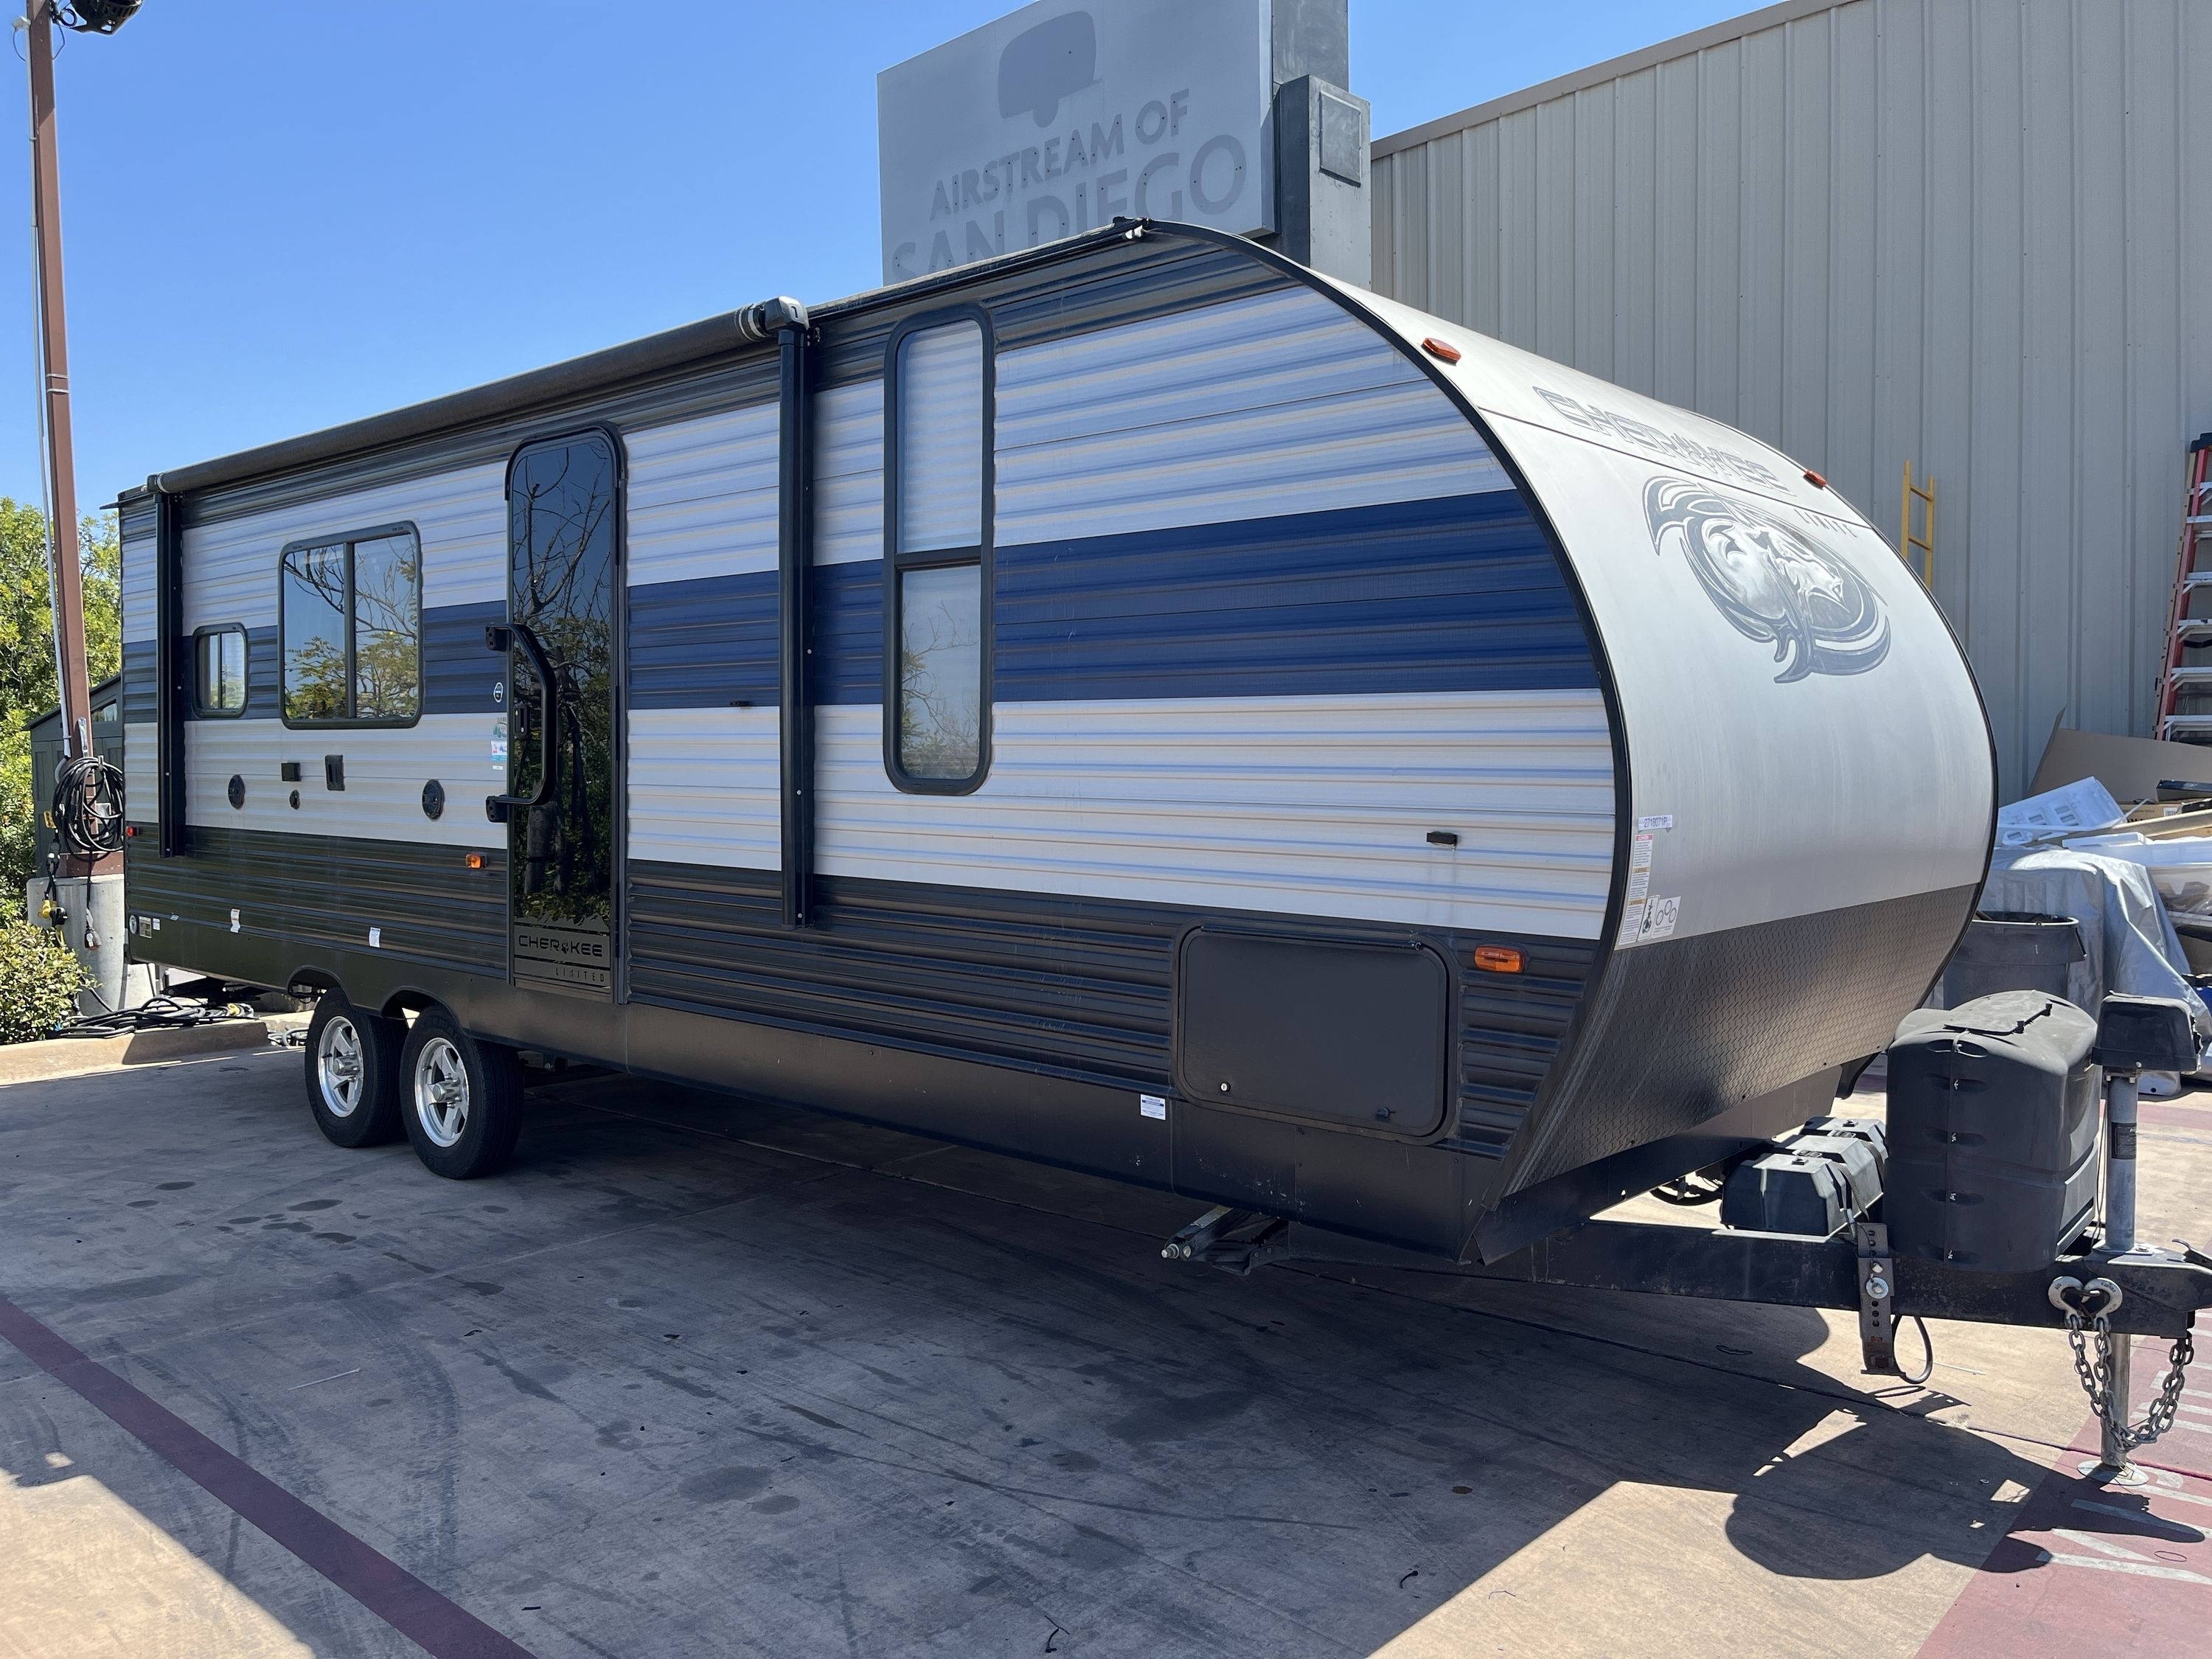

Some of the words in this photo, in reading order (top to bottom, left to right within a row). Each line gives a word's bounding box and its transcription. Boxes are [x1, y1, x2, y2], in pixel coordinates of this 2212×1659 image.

[891, 209, 1005, 279] SAN
[1026, 134, 1247, 246] DIEGO
[929, 114, 1124, 221] AIRSTREAM
[1135, 88, 1190, 145] OF
[556, 967, 605, 982] LIMITED
